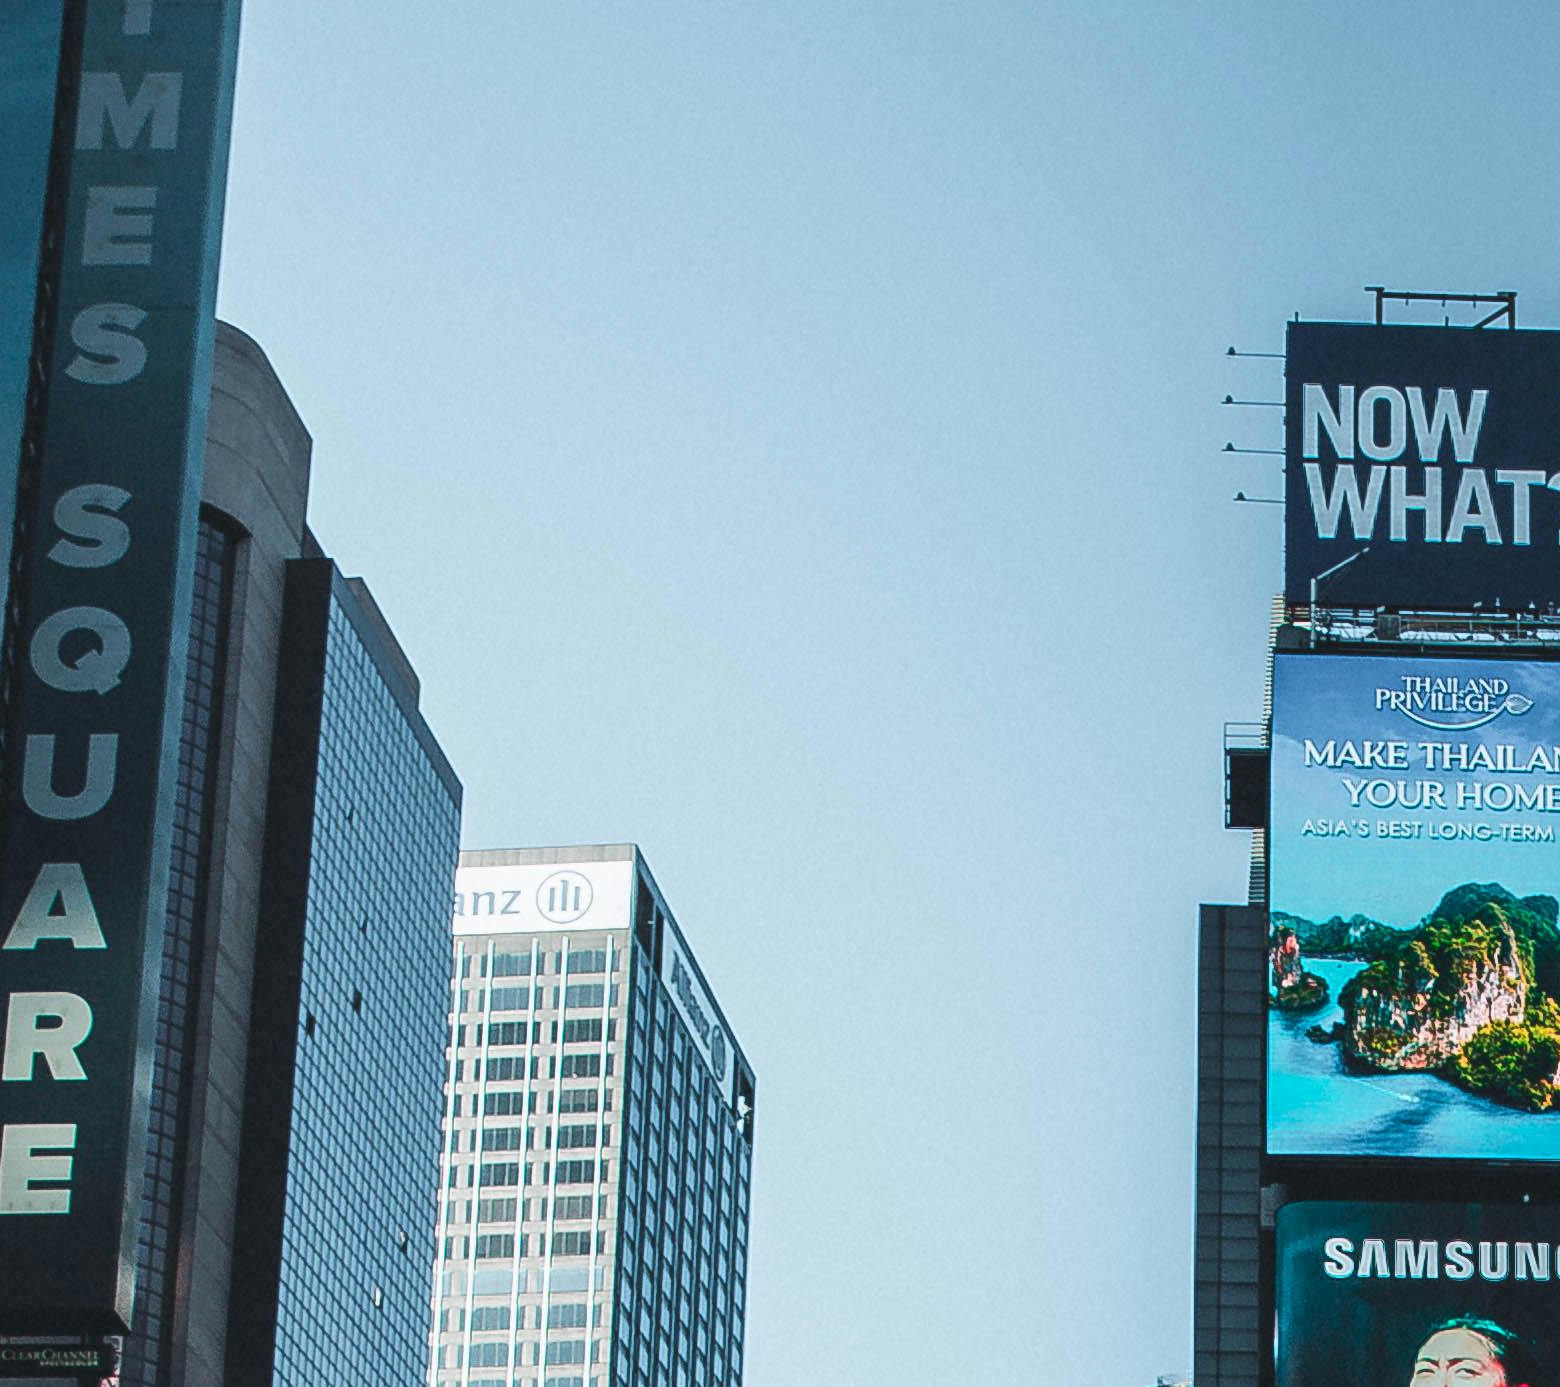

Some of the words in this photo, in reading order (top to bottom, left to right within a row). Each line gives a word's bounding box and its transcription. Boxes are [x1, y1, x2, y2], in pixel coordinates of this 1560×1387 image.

[1303, 383, 1488, 462] NOW
[1401, 676, 1508, 696] THAILAND
[1376, 688, 1497, 714] PRIVILEGE
[1303, 739, 1408, 769] MAKE
[1342, 779, 1446, 808] YOUR
[1301, 818, 1369, 838] ASIA'S
[1377, 820, 1422, 839] BEST
[1429, 822, 1554, 841] LONG-TERM
